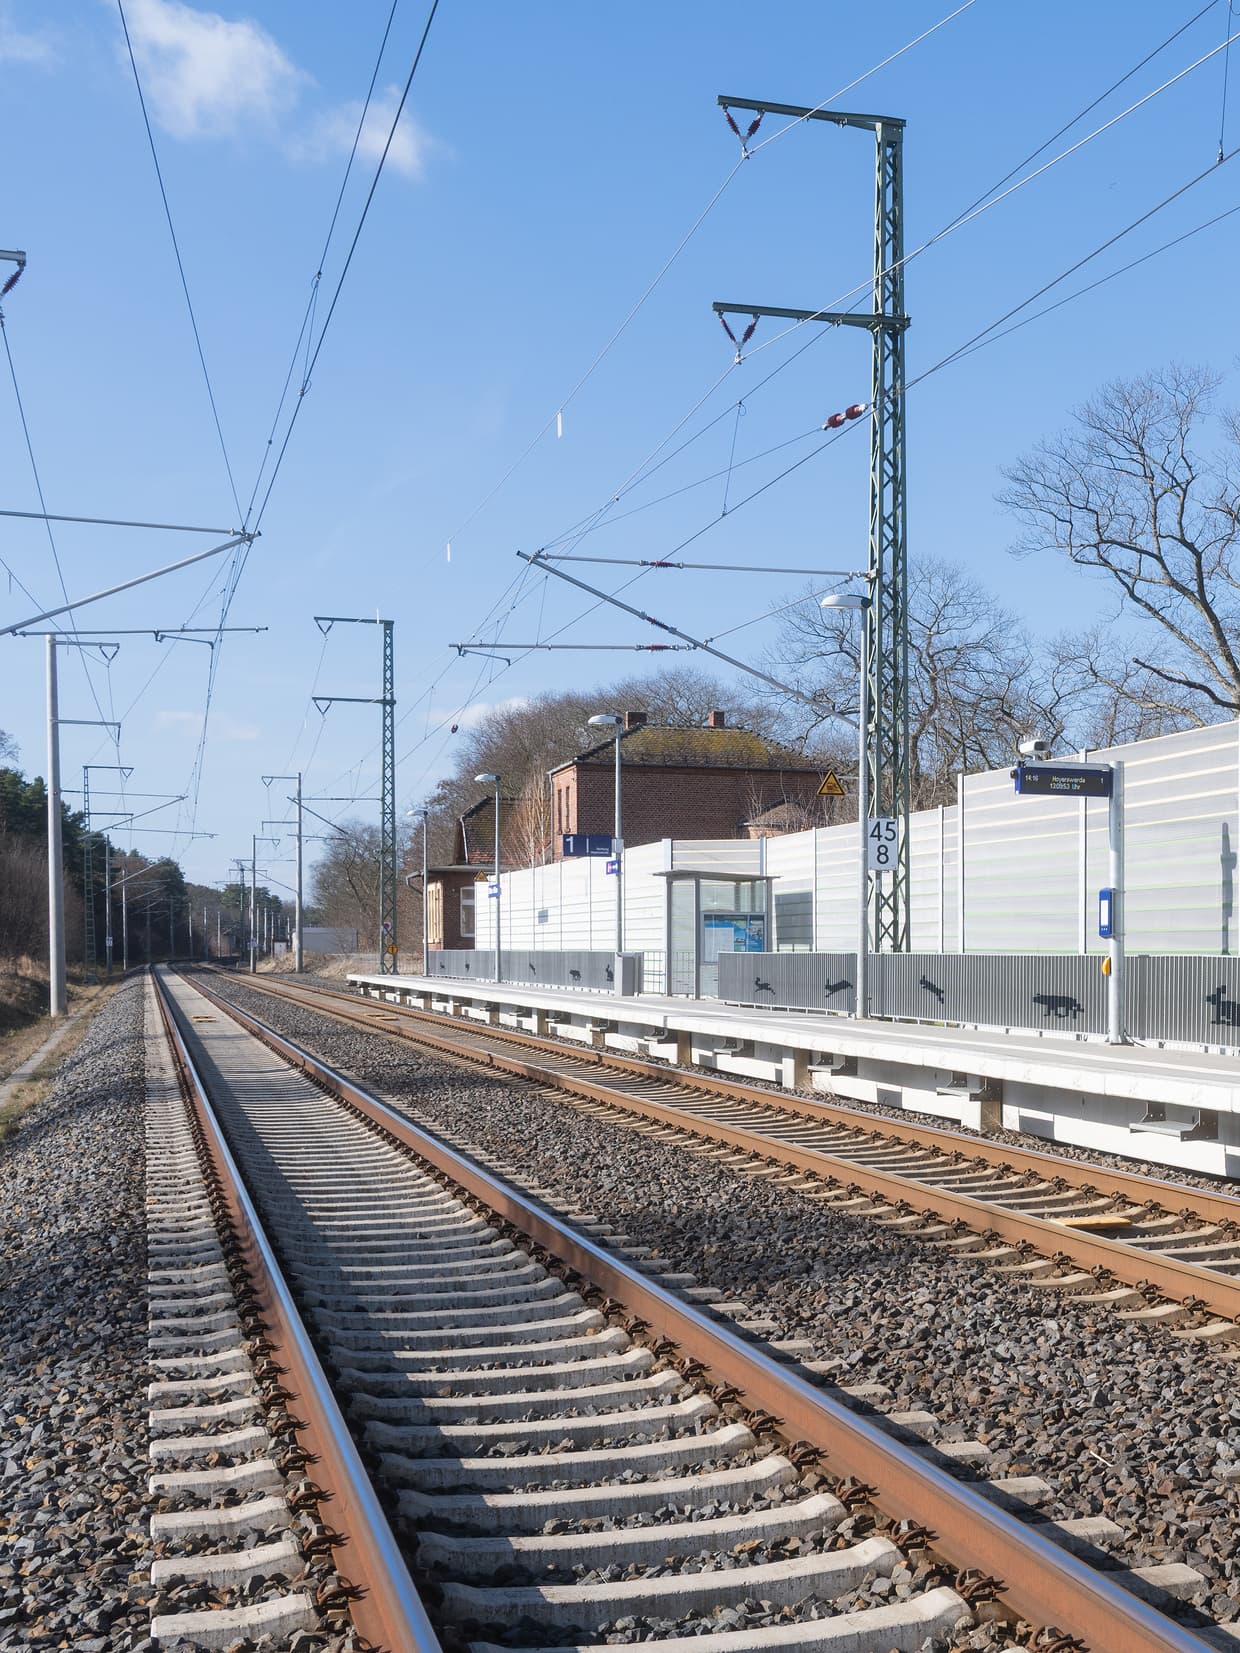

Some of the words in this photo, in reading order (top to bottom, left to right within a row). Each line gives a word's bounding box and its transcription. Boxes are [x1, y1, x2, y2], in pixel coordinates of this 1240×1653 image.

[869, 821, 897, 841] 45
[565, 836, 574, 853] 1
[876, 844, 890, 864] 8
